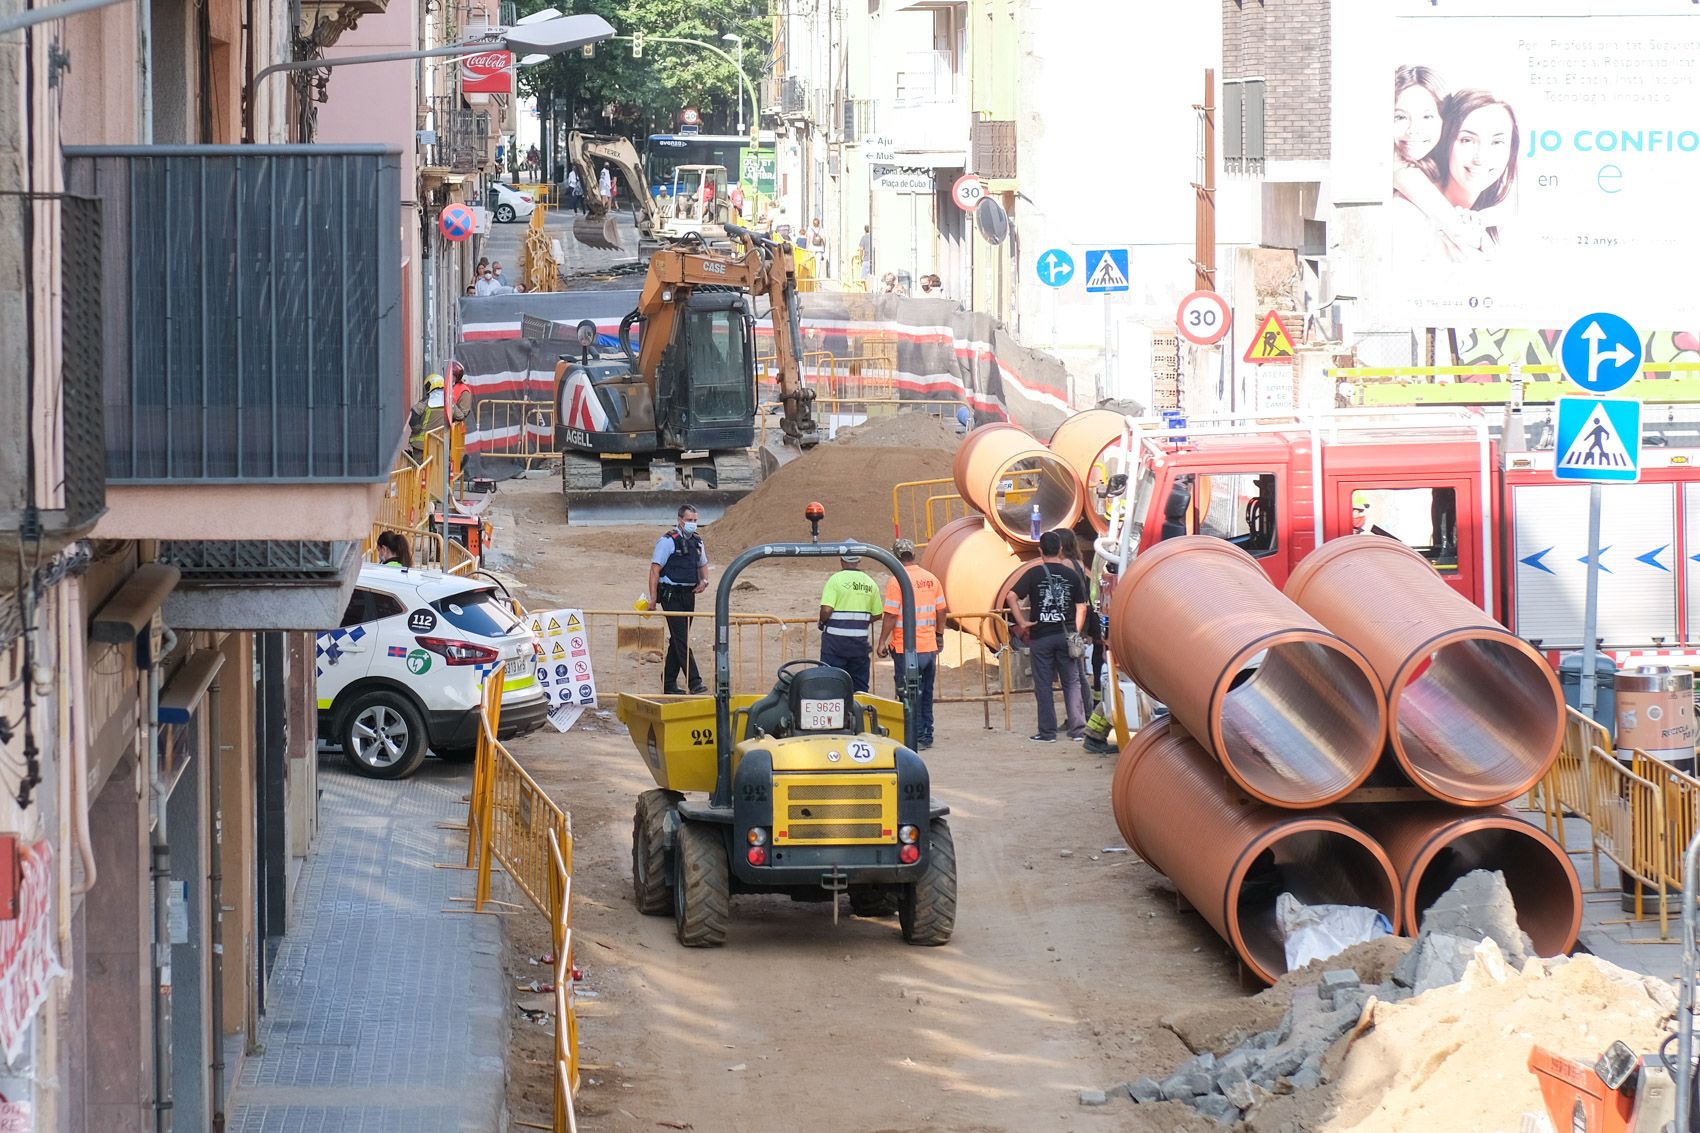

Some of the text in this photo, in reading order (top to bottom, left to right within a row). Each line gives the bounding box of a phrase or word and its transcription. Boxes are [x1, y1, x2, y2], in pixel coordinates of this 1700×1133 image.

[877, 137, 893, 147] Aju
[1527, 130, 1700, 158] JO CONFIO
[604, 147, 621, 159] TEREX
[876, 152, 895, 160] Mus
[900, 180, 908, 188] de
[909, 180, 926, 188] Cuba
[1538, 174, 1558, 187] en
[961, 187, 980, 199] 30
[1593, 237, 1618, 247] anys
[703, 261, 727, 275] CASE
[1189, 309, 1217, 327] 30
[566, 429, 593, 448] AGELL
[412, 614, 433, 626] 112
[805, 702, 841, 713] E 9626
[691, 728, 714, 746] 22
[852, 743, 871, 759] 25
[903, 783, 925, 801] 22
